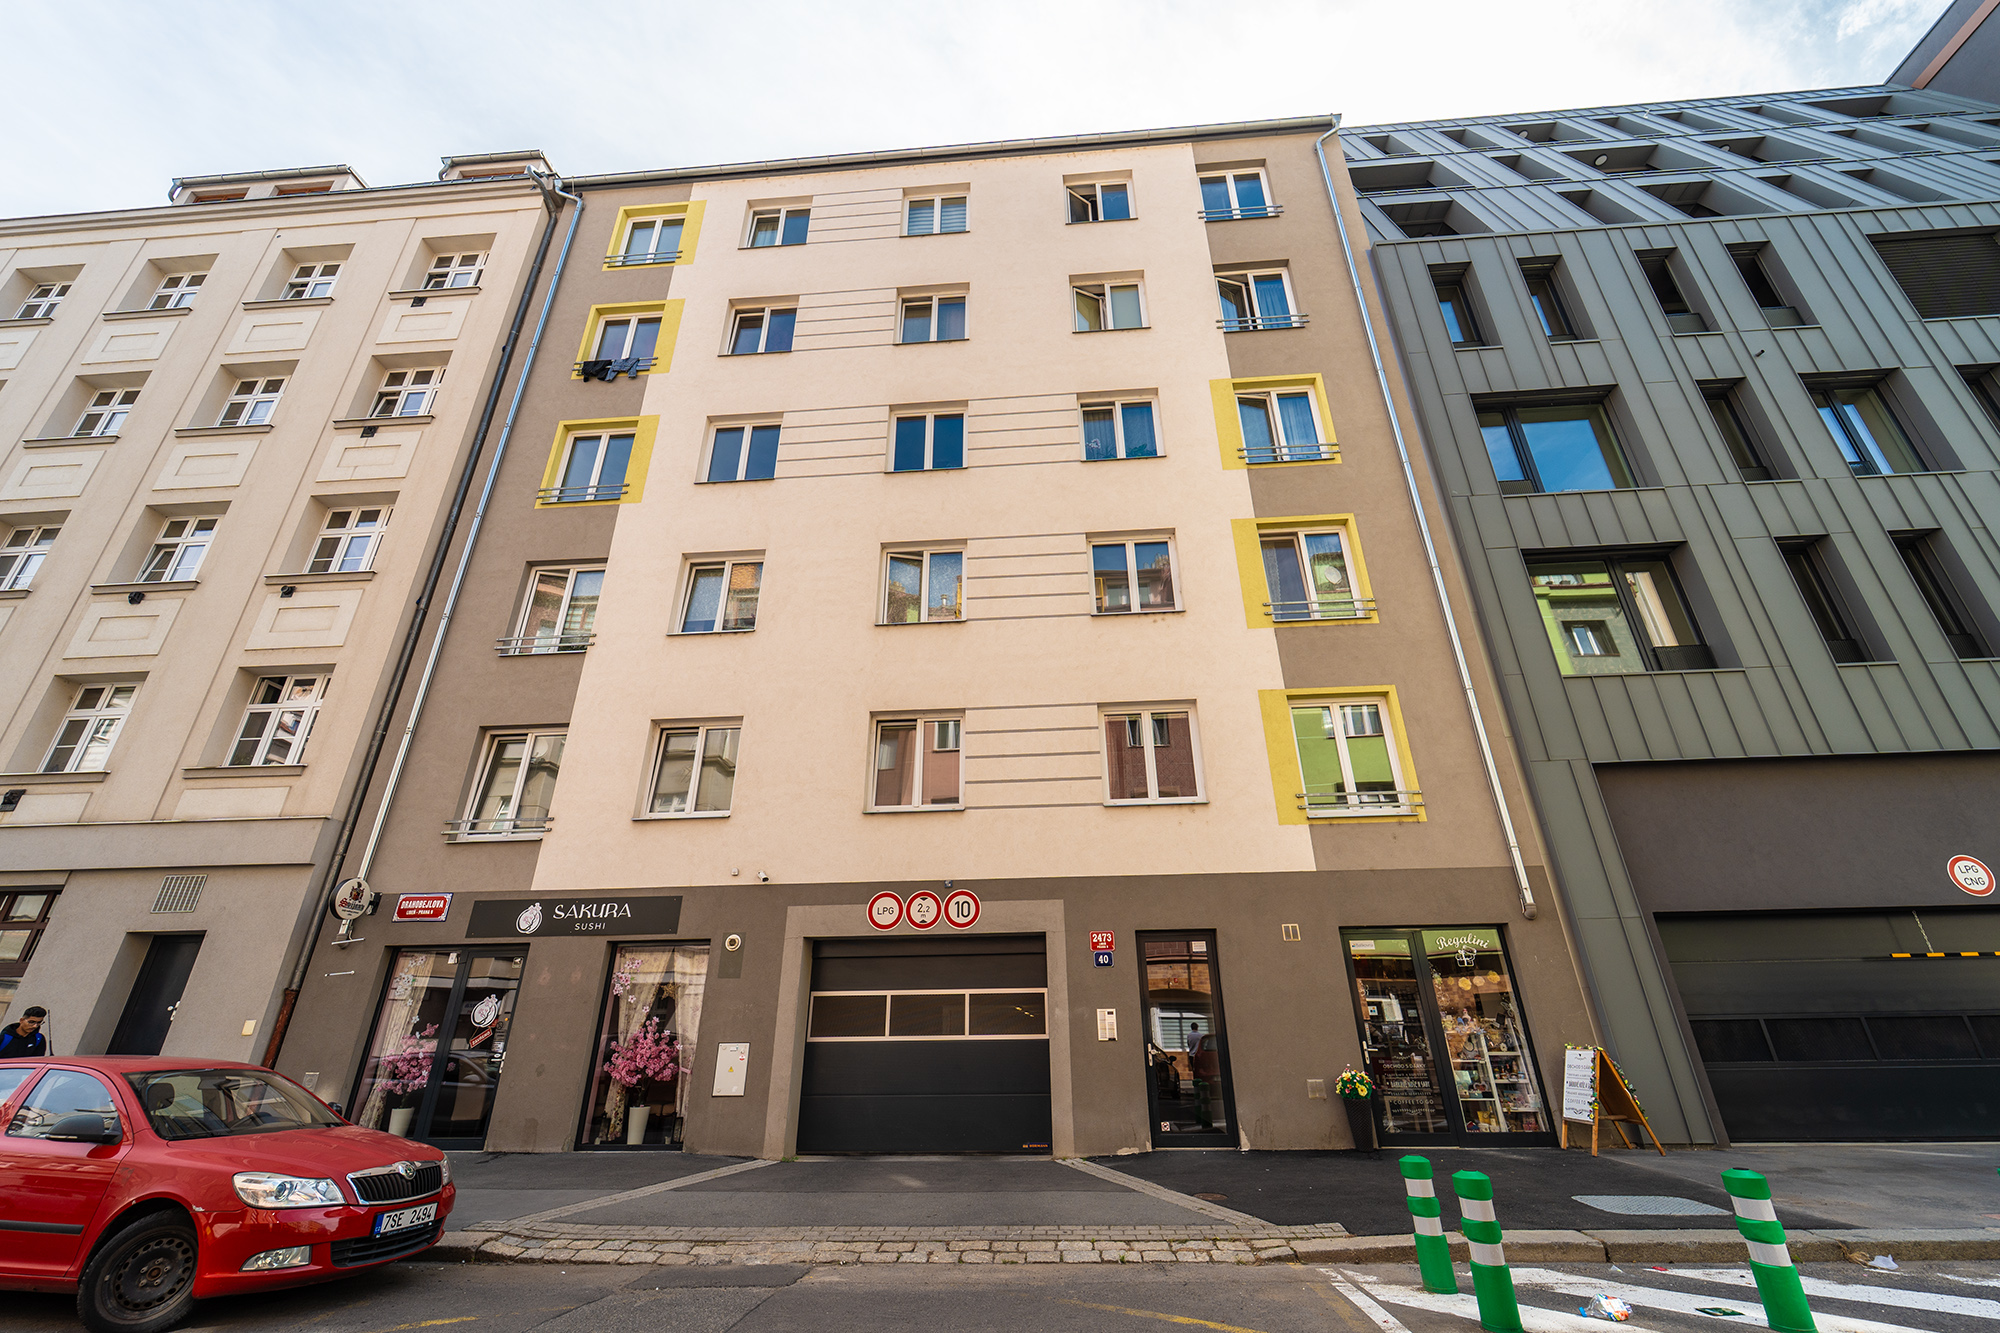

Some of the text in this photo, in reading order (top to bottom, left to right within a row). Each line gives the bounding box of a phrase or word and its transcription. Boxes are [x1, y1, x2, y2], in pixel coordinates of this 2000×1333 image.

[1958, 865, 1979, 874] LPG
[1964, 877, 1986, 886] CNG
[400, 900, 444, 909] DRAHOBEJLOVA
[552, 902, 632, 920] SAKURA
[877, 906, 895, 915] LPG
[954, 901, 971, 919] 10
[574, 922, 606, 931] SUSHI
[1092, 933, 1112, 942] 2473
[1436, 933, 1490, 950] Regalini
[1098, 954, 1109, 964] 40
[384, 1212, 405, 1230] 7SE
[410, 1206, 433, 1224] 2494
